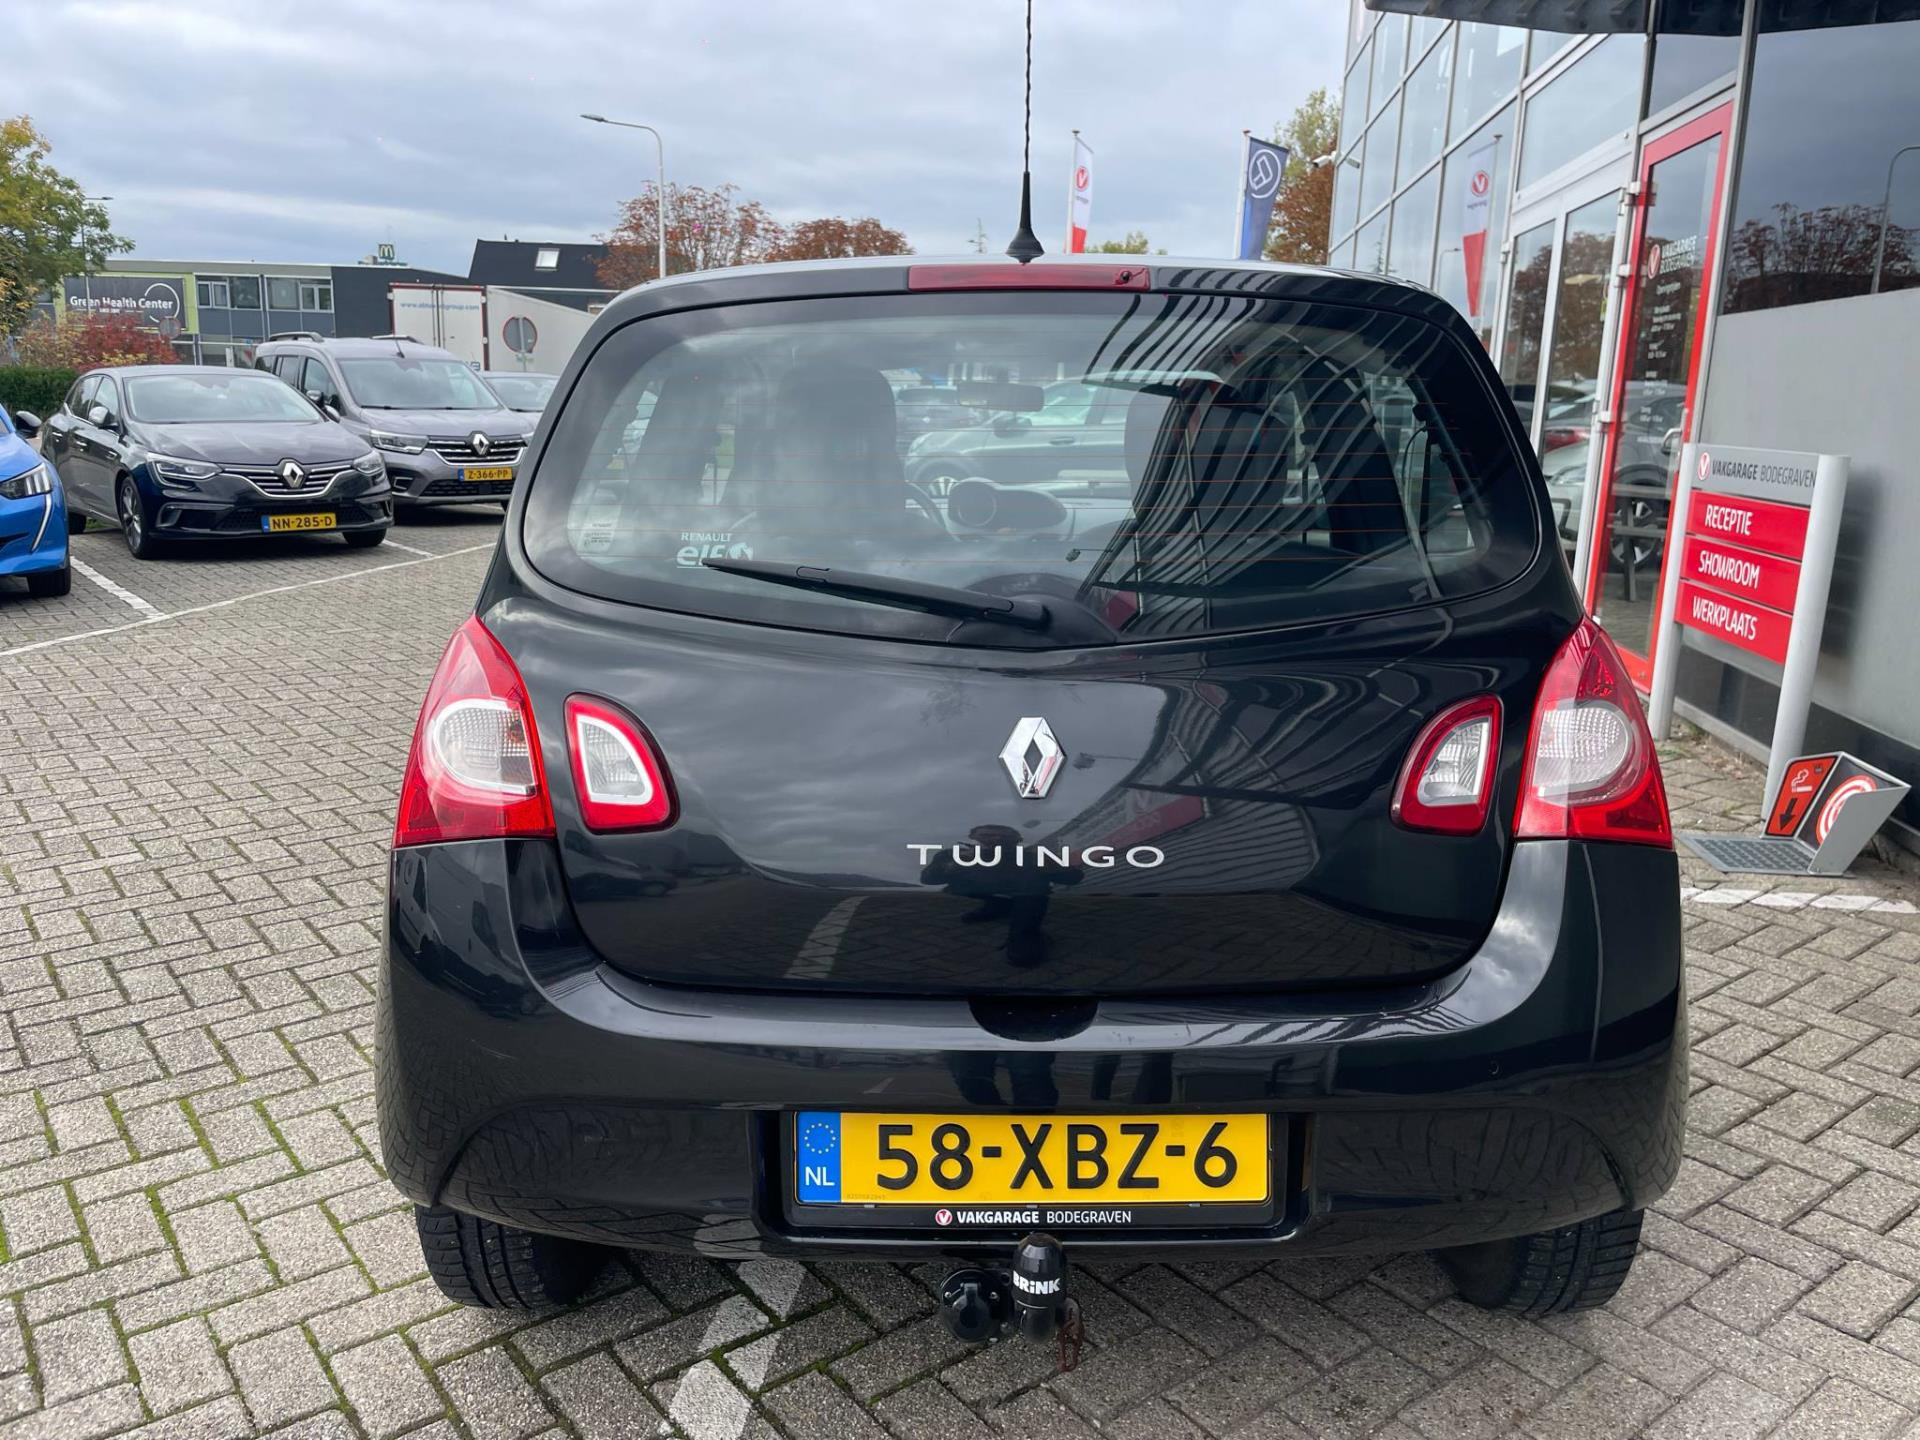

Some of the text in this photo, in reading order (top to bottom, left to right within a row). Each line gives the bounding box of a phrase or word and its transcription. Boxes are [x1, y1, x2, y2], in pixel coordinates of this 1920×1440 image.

[70, 296, 174, 309] Green Health Center
[1712, 459, 1758, 480] VAKGARAGE
[1760, 464, 1817, 488] BODEGRAVEN
[272, 516, 333, 529] NN-285-D
[1705, 504, 1753, 536] RECEPTIE
[681, 532, 733, 542] RENAULT
[1698, 550, 1760, 590] SHOWROOM
[1692, 595, 1758, 640] WERKPLAATS
[906, 844, 1165, 868] TWINGO
[877, 1122, 1238, 1191] 58-XBZ-6
[805, 1166, 835, 1186] NL
[956, 1211, 1040, 1224] VAKGARAGE
[1046, 1211, 1132, 1224] BODEGRAVEN
